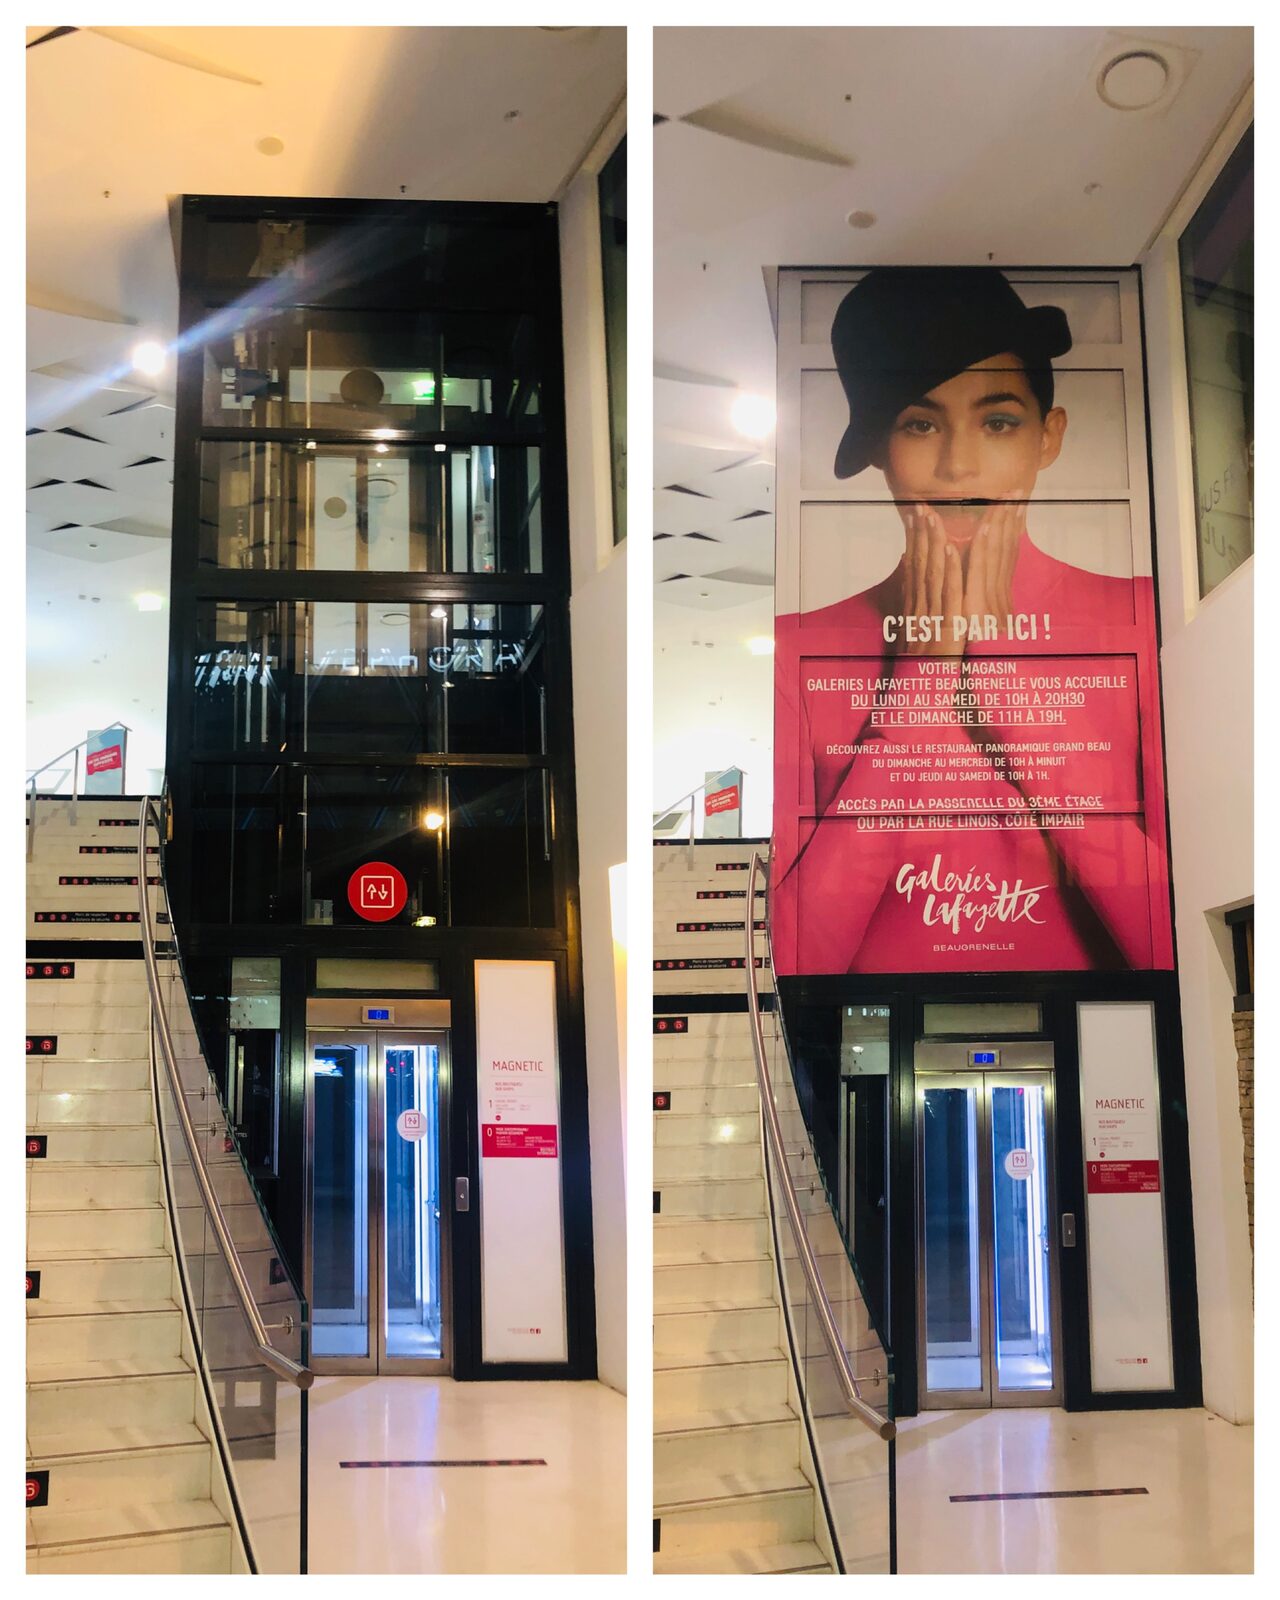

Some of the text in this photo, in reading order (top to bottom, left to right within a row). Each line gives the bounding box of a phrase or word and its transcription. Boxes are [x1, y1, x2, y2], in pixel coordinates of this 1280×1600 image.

[952, 613, 998, 642] PAR
[1006, 613, 1037, 641] ICI
[1043, 613, 1052, 641] !
[918, 661, 1017, 675] VOTRE MAGASIN
[807, 675, 1127, 691] GALERIES LAFAYETTE BEAUGRENELLE VOUS ACCUEILLE
[851, 690, 1086, 707] DU LUNDI AU SAMEDI DE 10H À 20H30
[871, 708, 1067, 724] ET LE DIMANCHE DE 11H À 19H.
[826, 742, 1111, 755] DÉCOUVREZ AUSSI LE RESTAURANT PANORAMIQUE GRAND BEAU
[872, 755, 1067, 768] DU DIMANCHE AU MERCREDI DE 10H À MINUIT
[890, 769, 1050, 782] ET DU JEUDI AU SAMEDI DE 10H À 1H.
[837, 797, 877, 811] ACCÈS
[909, 798, 925, 810] LA
[1007, 797, 1025, 809] DU
[1028, 794, 1062, 808] 3ÈME
[1065, 794, 1104, 807] ÉTAGE
[857, 811, 1085, 830] OU PAR LA RUE LINOIS, CÔTÉ IMPAIR
[932, 942, 1016, 952] BEAUGRENELLE
[376, 1010, 382, 1019] 0
[982, 1053, 988, 1063] 0
[492, 1060, 544, 1072] MAGNETIC
[1095, 1098, 1145, 1110] MAGNETIC
[487, 1127, 493, 1137] 0
[1092, 1164, 1097, 1174] 0
